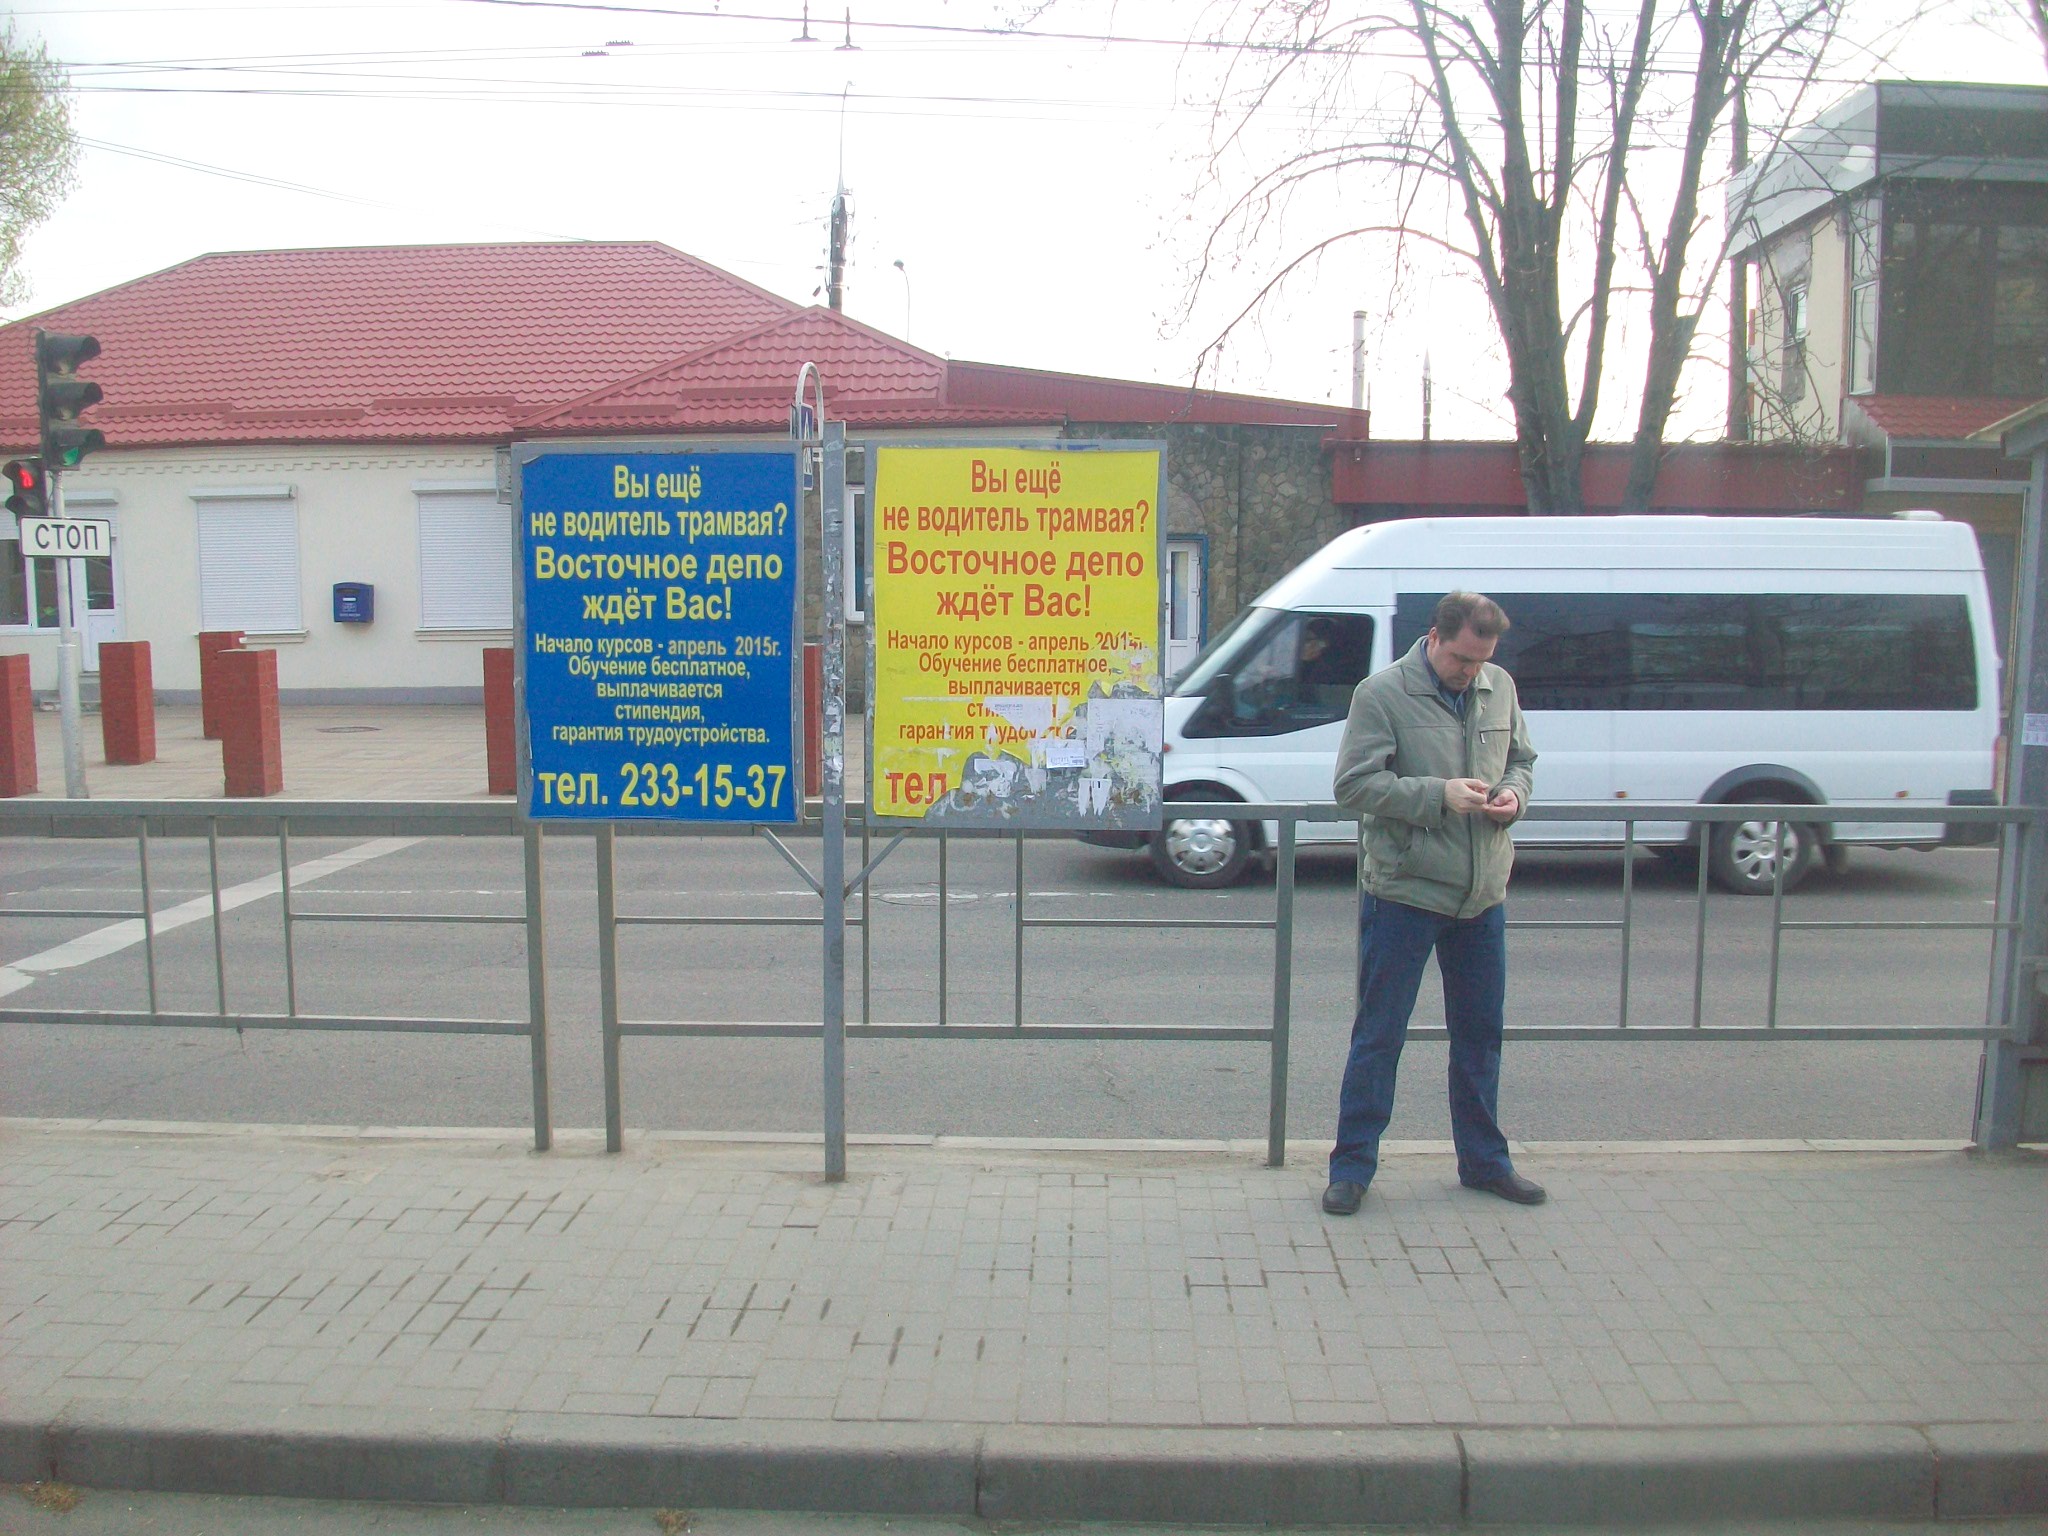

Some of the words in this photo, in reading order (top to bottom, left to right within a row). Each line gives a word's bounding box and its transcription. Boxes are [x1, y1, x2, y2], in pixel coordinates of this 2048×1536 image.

[614, 465, 649, 499] Вы
[656, 466, 701, 503] ещё
[972, 460, 1007, 492] Вы
[1015, 462, 1061, 499] ещё
[531, 512, 556, 536] не
[563, 511, 670, 540] водитель
[677, 501, 787, 543] трамвая?
[884, 506, 909, 531] не
[918, 507, 1029, 536] водитель
[1036, 498, 1149, 540] трамвая?
[35, 523, 98, 550] СТОП
[535, 546, 697, 580] Восточное
[706, 554, 782, 584] депо
[888, 541, 1056, 575] Восточное
[1066, 551, 1143, 581] депо
[583, 588, 656, 624] ждёт
[666, 586, 730, 620] Вас!
[937, 584, 1014, 621] ждёт
[1025, 584, 1090, 617] Вас!
[536, 634, 593, 654] Начало
[598, 639, 654, 660] курсов
[668, 640, 727, 659] апрель
[735, 636, 781, 656] 2015г.
[888, 631, 948, 653] Начало
[954, 635, 1013, 657] курсов
[1029, 636, 1089, 655] апрель
[569, 654, 646, 679] Обучение
[651, 655, 750, 679] бесплатное,
[919, 652, 1001, 677] Обучение
[1007, 653, 1112, 676] бесплатное,
[597, 682, 722, 699] выплачивается
[949, 680, 1080, 696] выплачивается
[615, 704, 704, 723] стипендия,
[552, 725, 623, 745] гарантия
[627, 723, 770, 747] трудоустройства.
[538, 773, 608, 805] тел.
[621, 763, 786, 808] 233-15-37
